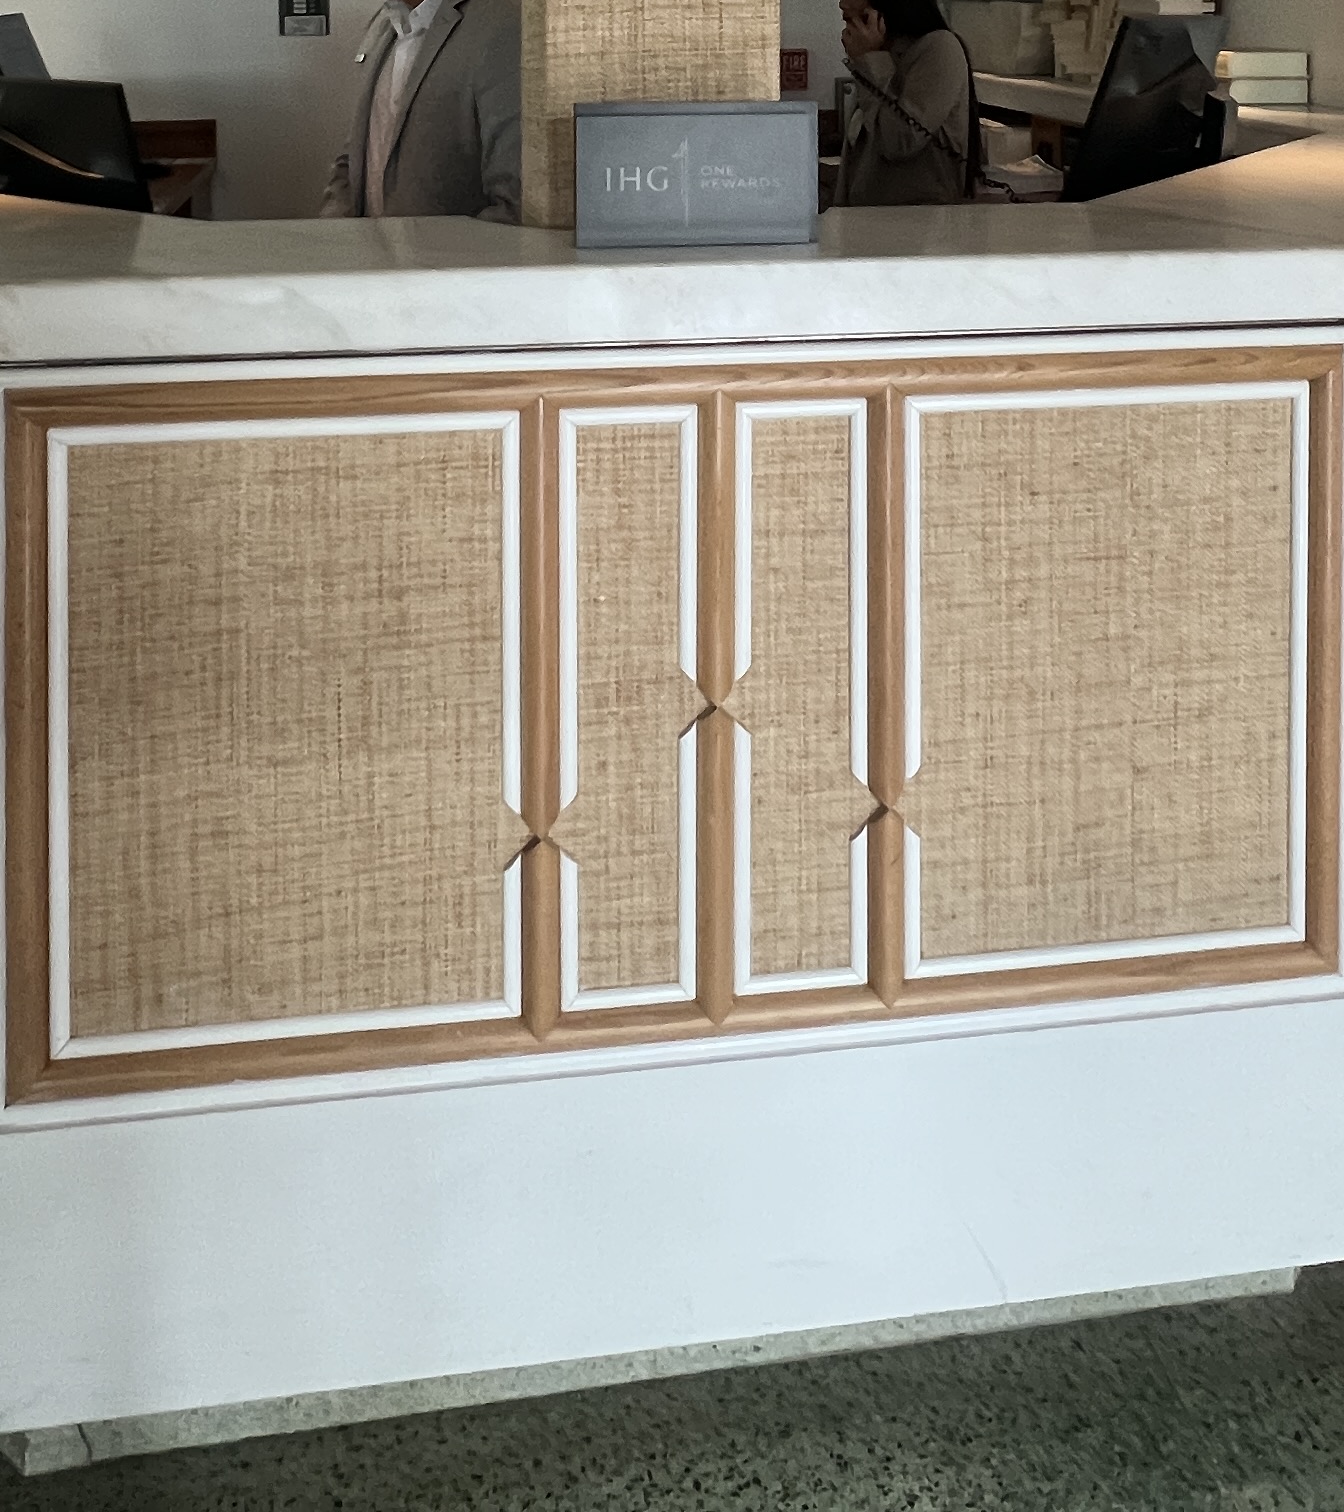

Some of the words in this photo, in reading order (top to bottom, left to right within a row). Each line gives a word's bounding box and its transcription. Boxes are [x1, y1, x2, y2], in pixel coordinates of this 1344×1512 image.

[783, 53, 806, 71] FIRE
[700, 164, 736, 177] ONE
[605, 165, 669, 192] IHG
[700, 177, 783, 190] REWARDS
